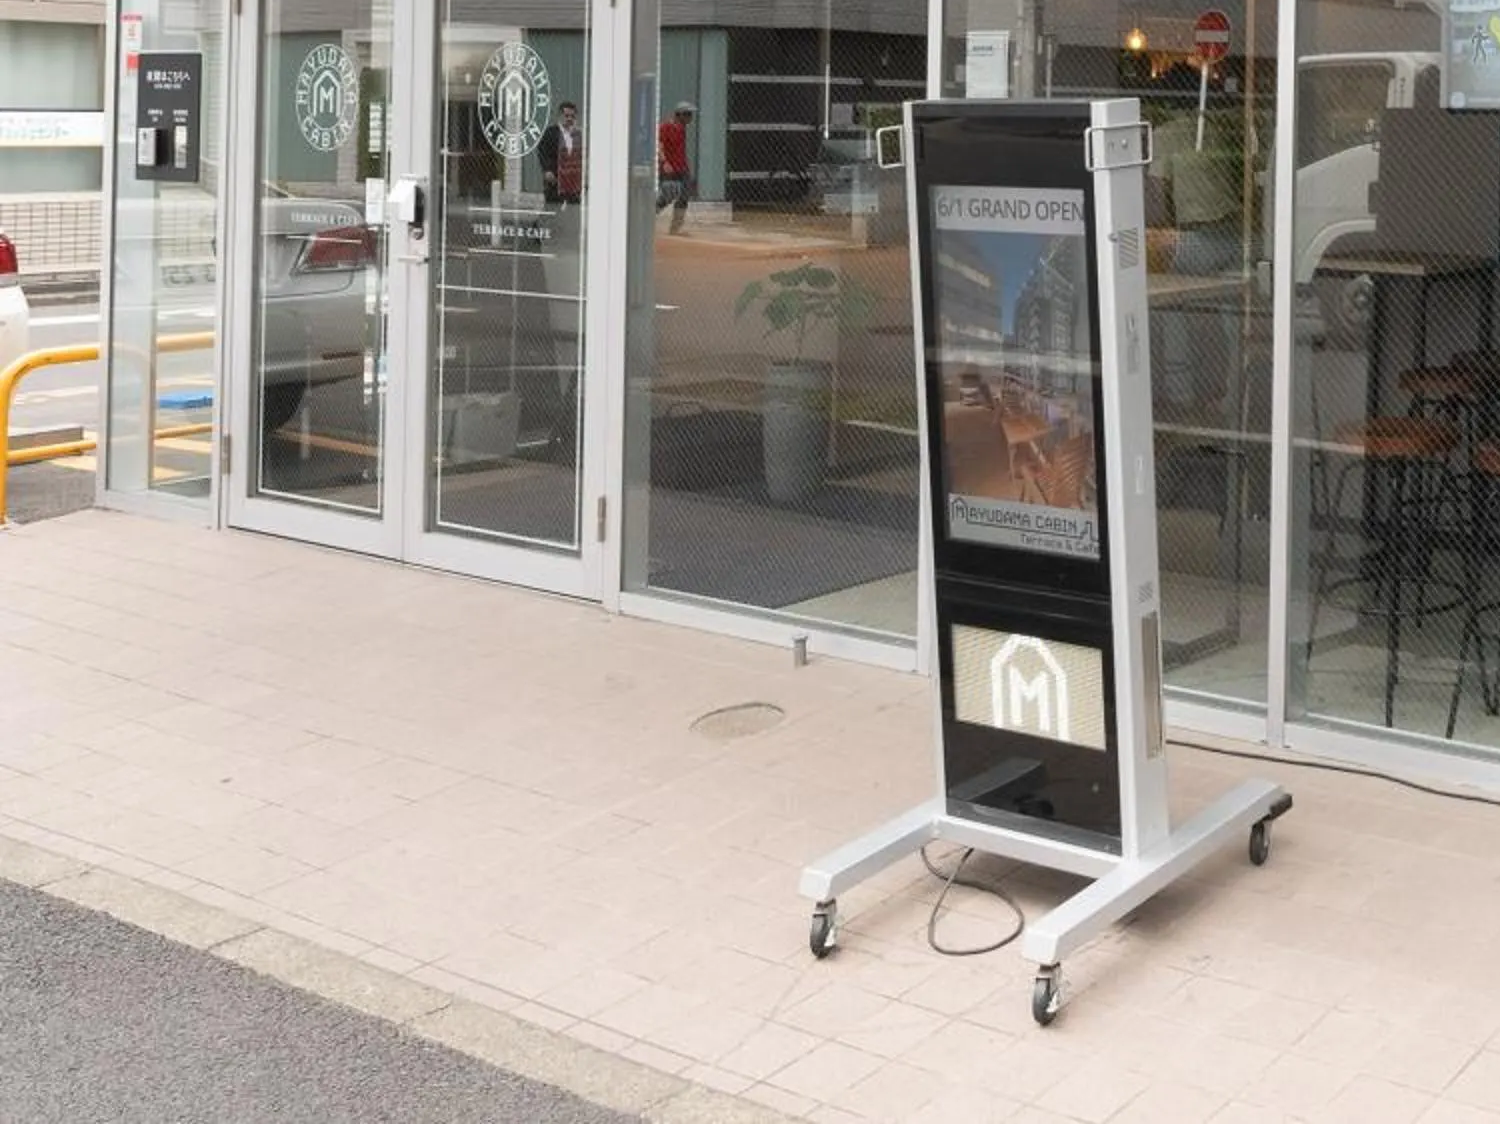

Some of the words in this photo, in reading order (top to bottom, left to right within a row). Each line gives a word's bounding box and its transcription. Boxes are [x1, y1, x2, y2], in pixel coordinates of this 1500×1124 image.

[480, 47, 549, 107] MAYUDAMA
[968, 197, 1031, 221] GRAND
[1034, 199, 1085, 222] OPEN
